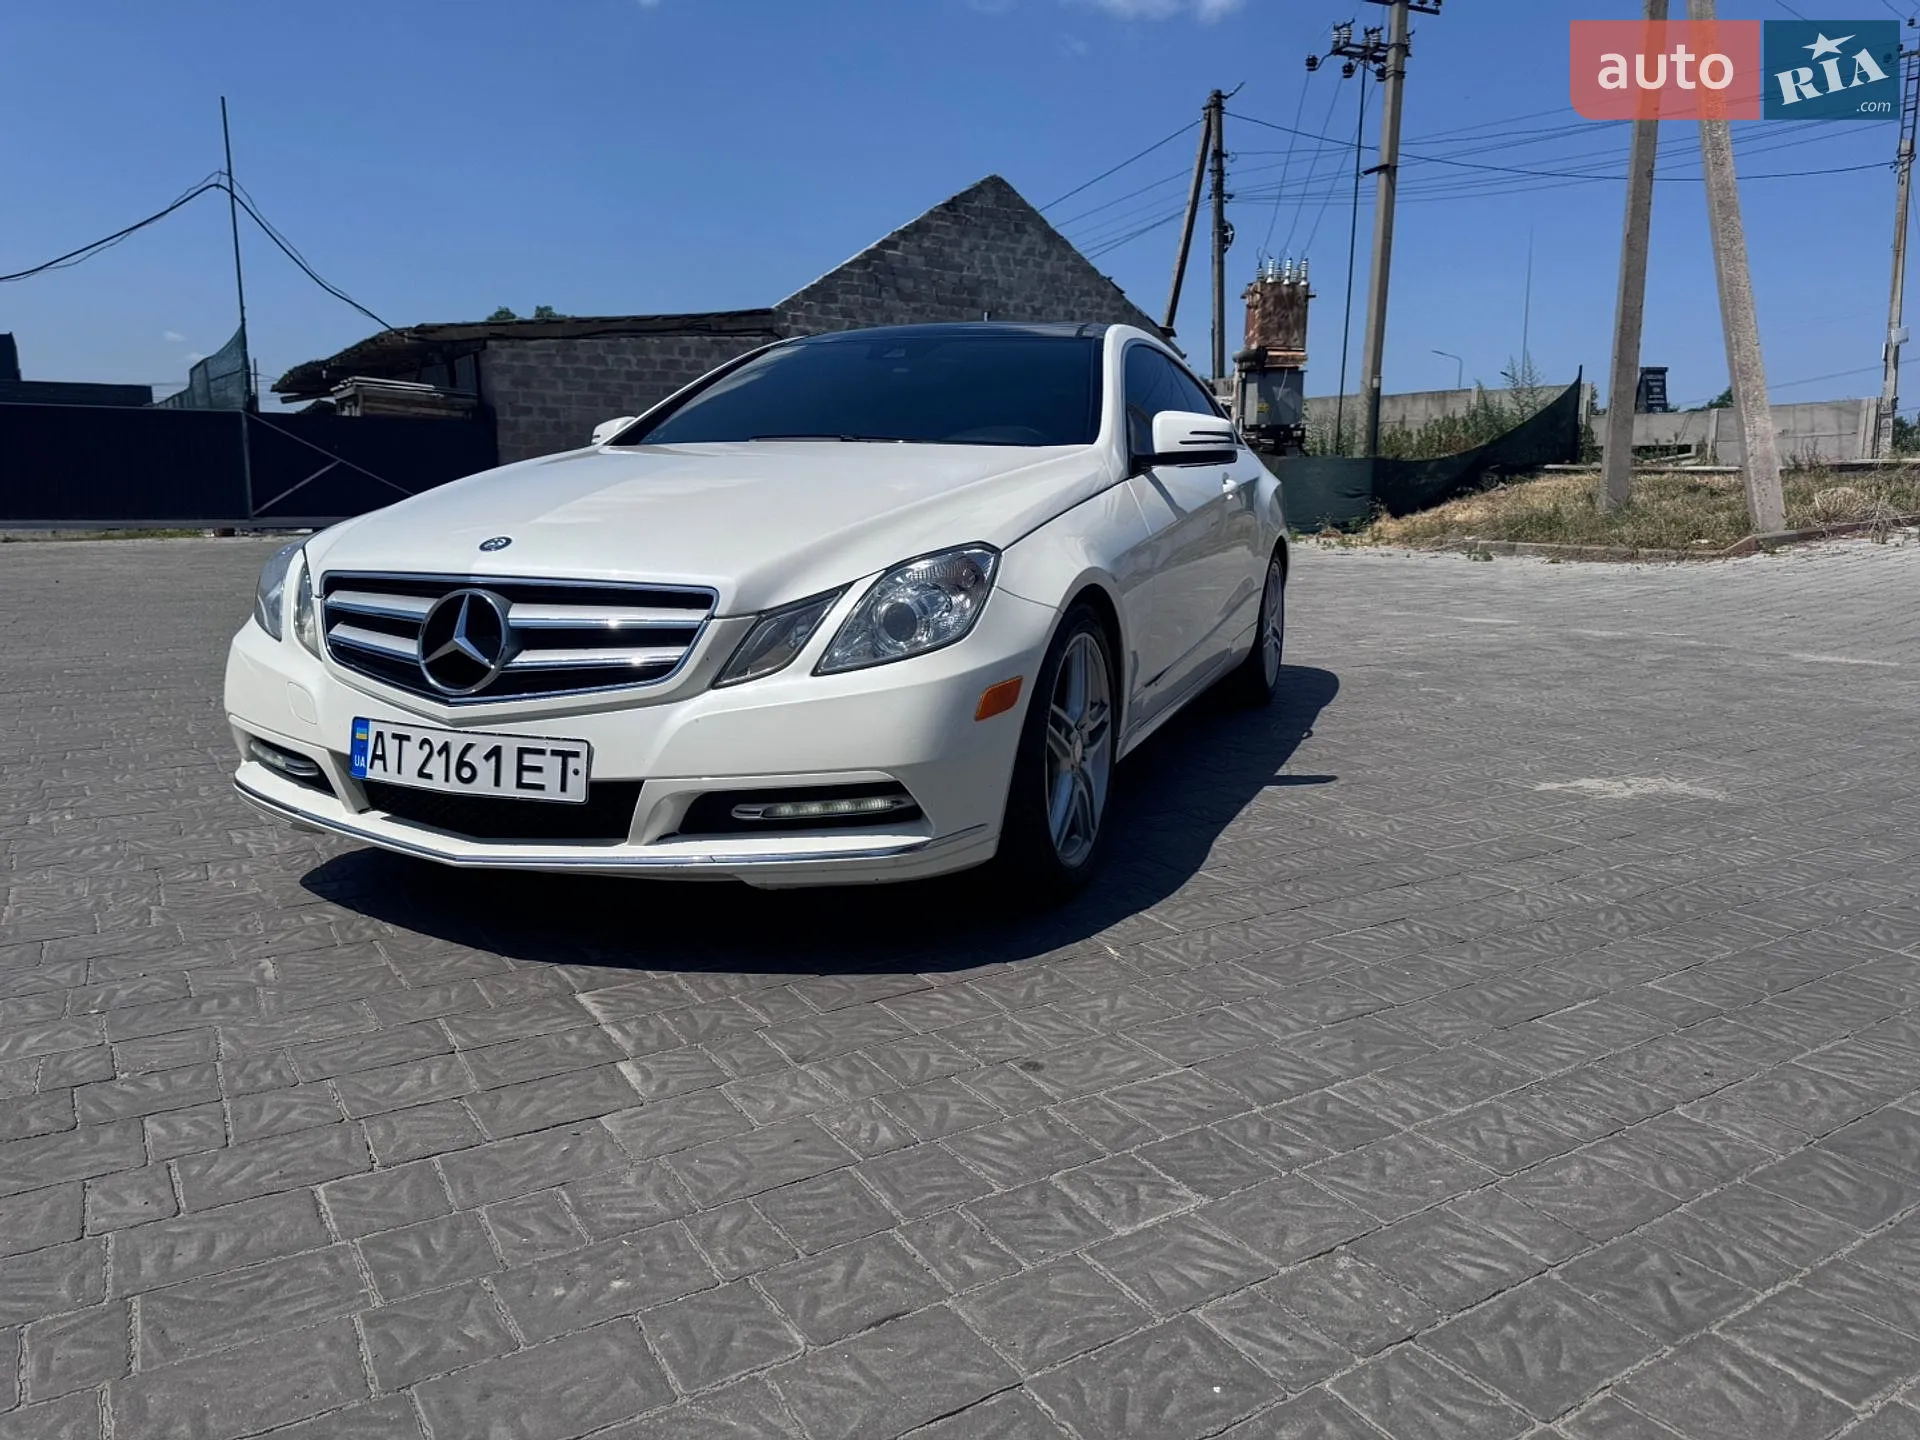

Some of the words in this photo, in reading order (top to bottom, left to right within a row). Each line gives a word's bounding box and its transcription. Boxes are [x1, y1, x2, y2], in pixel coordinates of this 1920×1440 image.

[354, 755, 365, 767] UA
[369, 731, 411, 775] AT
[417, 738, 502, 787] 2161
[516, 746, 580, 792] ET
